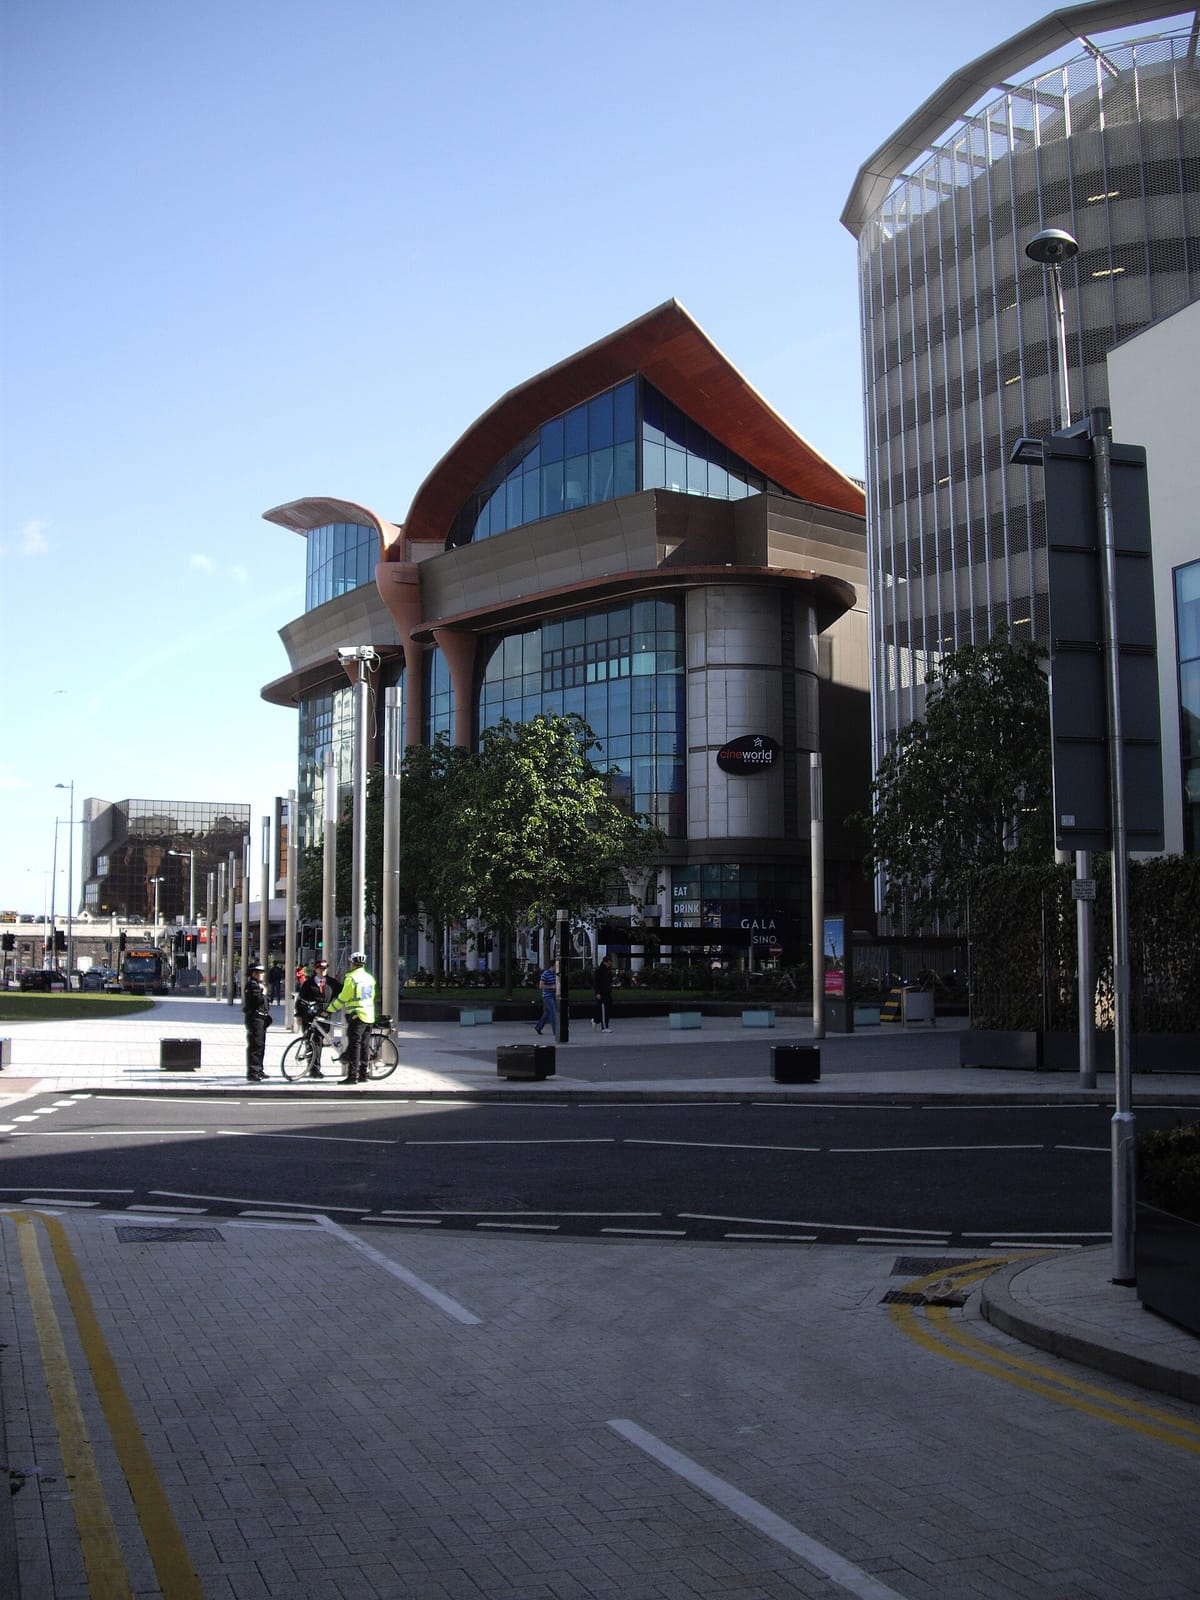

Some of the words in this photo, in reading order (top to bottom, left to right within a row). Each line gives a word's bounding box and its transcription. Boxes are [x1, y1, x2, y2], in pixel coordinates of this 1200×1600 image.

[720, 749, 772, 760] cineworld
[673, 886, 688, 897] EAT
[673, 903, 699, 914] DRINK
[740, 918, 776, 929] GALA
[752, 935, 777, 944] SINO
